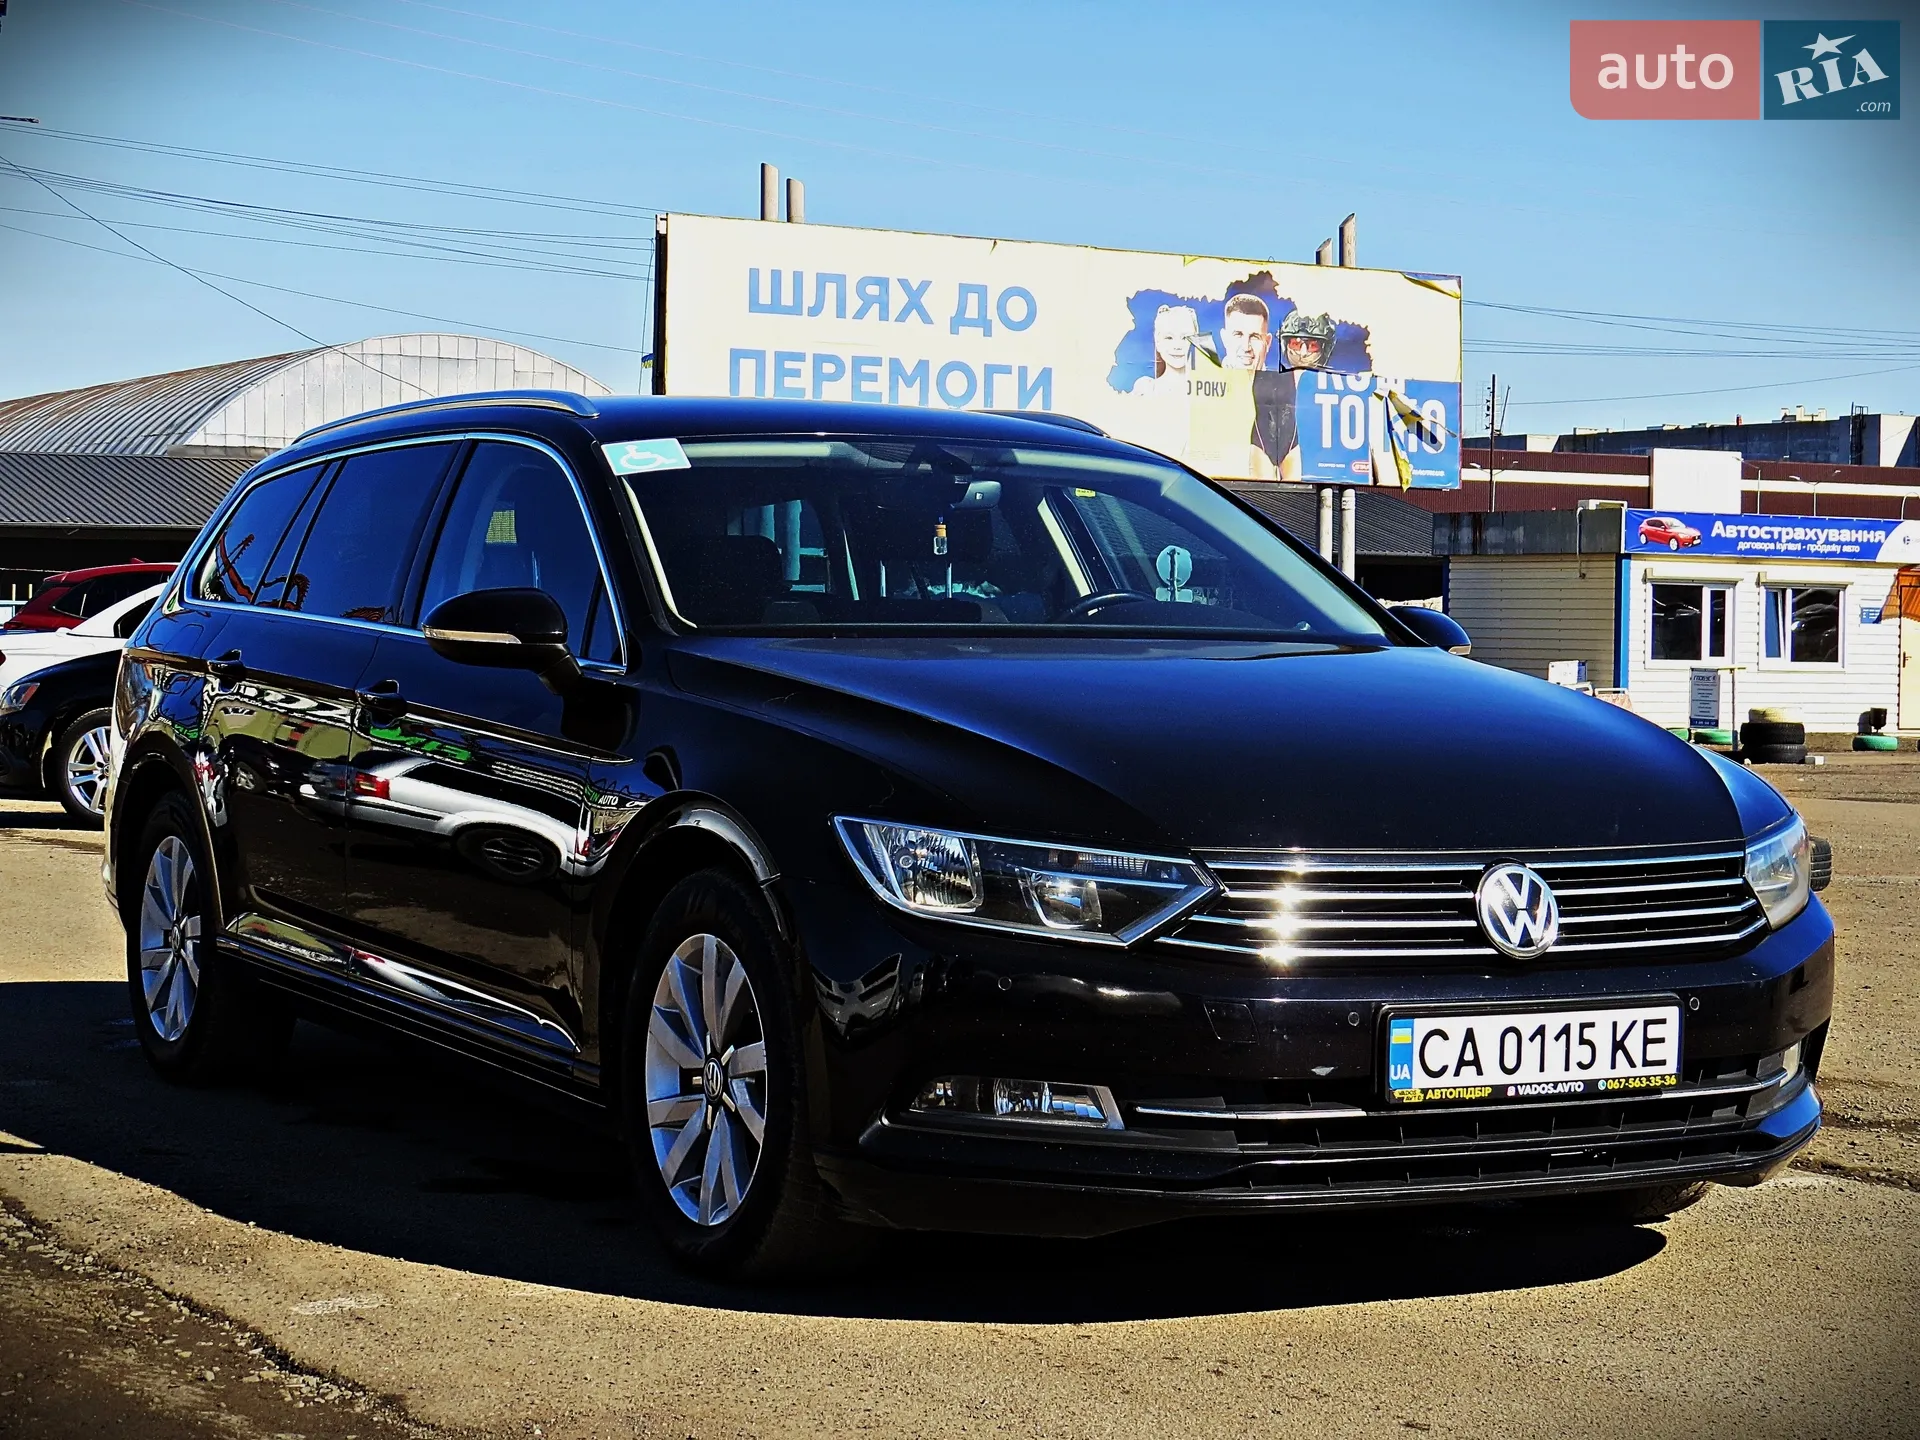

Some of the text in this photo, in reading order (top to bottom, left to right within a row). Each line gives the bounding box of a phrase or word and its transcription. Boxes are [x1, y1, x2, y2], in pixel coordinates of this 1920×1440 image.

[748, 267, 1038, 338] ШЛЯХ ДО
[729, 347, 1053, 411] ПЕРЕМОГИ
[1196, 380, 1227, 398] РОКУ
[1710, 520, 1886, 545] Автострахування
[1418, 1018, 1667, 1079] CA 0115 KE
[1389, 1063, 1411, 1081] UA
[1517, 1081, 1584, 1096] VADOS.AVTO
[1607, 1074, 1677, 1090] 067-563-35-36
[1426, 1086, 1493, 1100] АВТОПІДБІР
